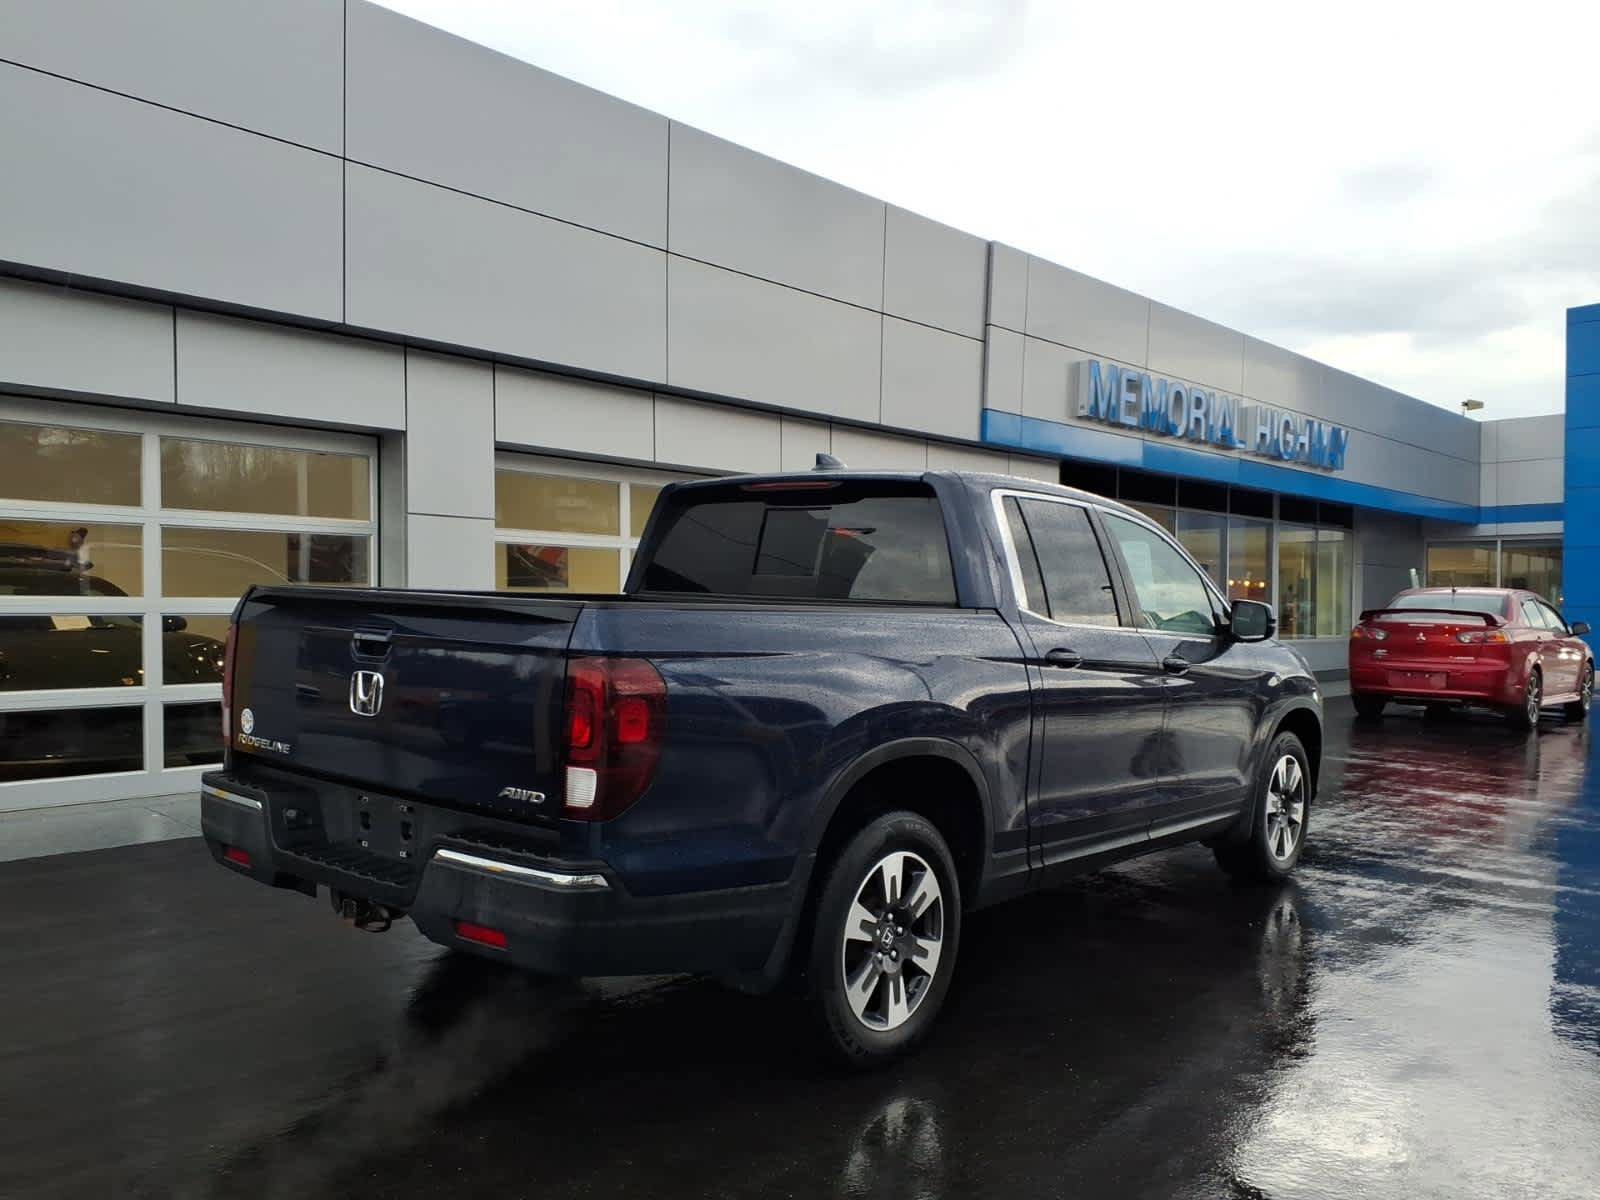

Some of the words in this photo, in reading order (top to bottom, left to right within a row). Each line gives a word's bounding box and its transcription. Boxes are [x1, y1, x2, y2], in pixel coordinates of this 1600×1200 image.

[1085, 359, 1246, 449] MEMORIAL
[1256, 405, 1349, 471] HIGHWAY
[239, 733, 291, 754] RIDGELINE
[498, 786, 546, 804] AWD
